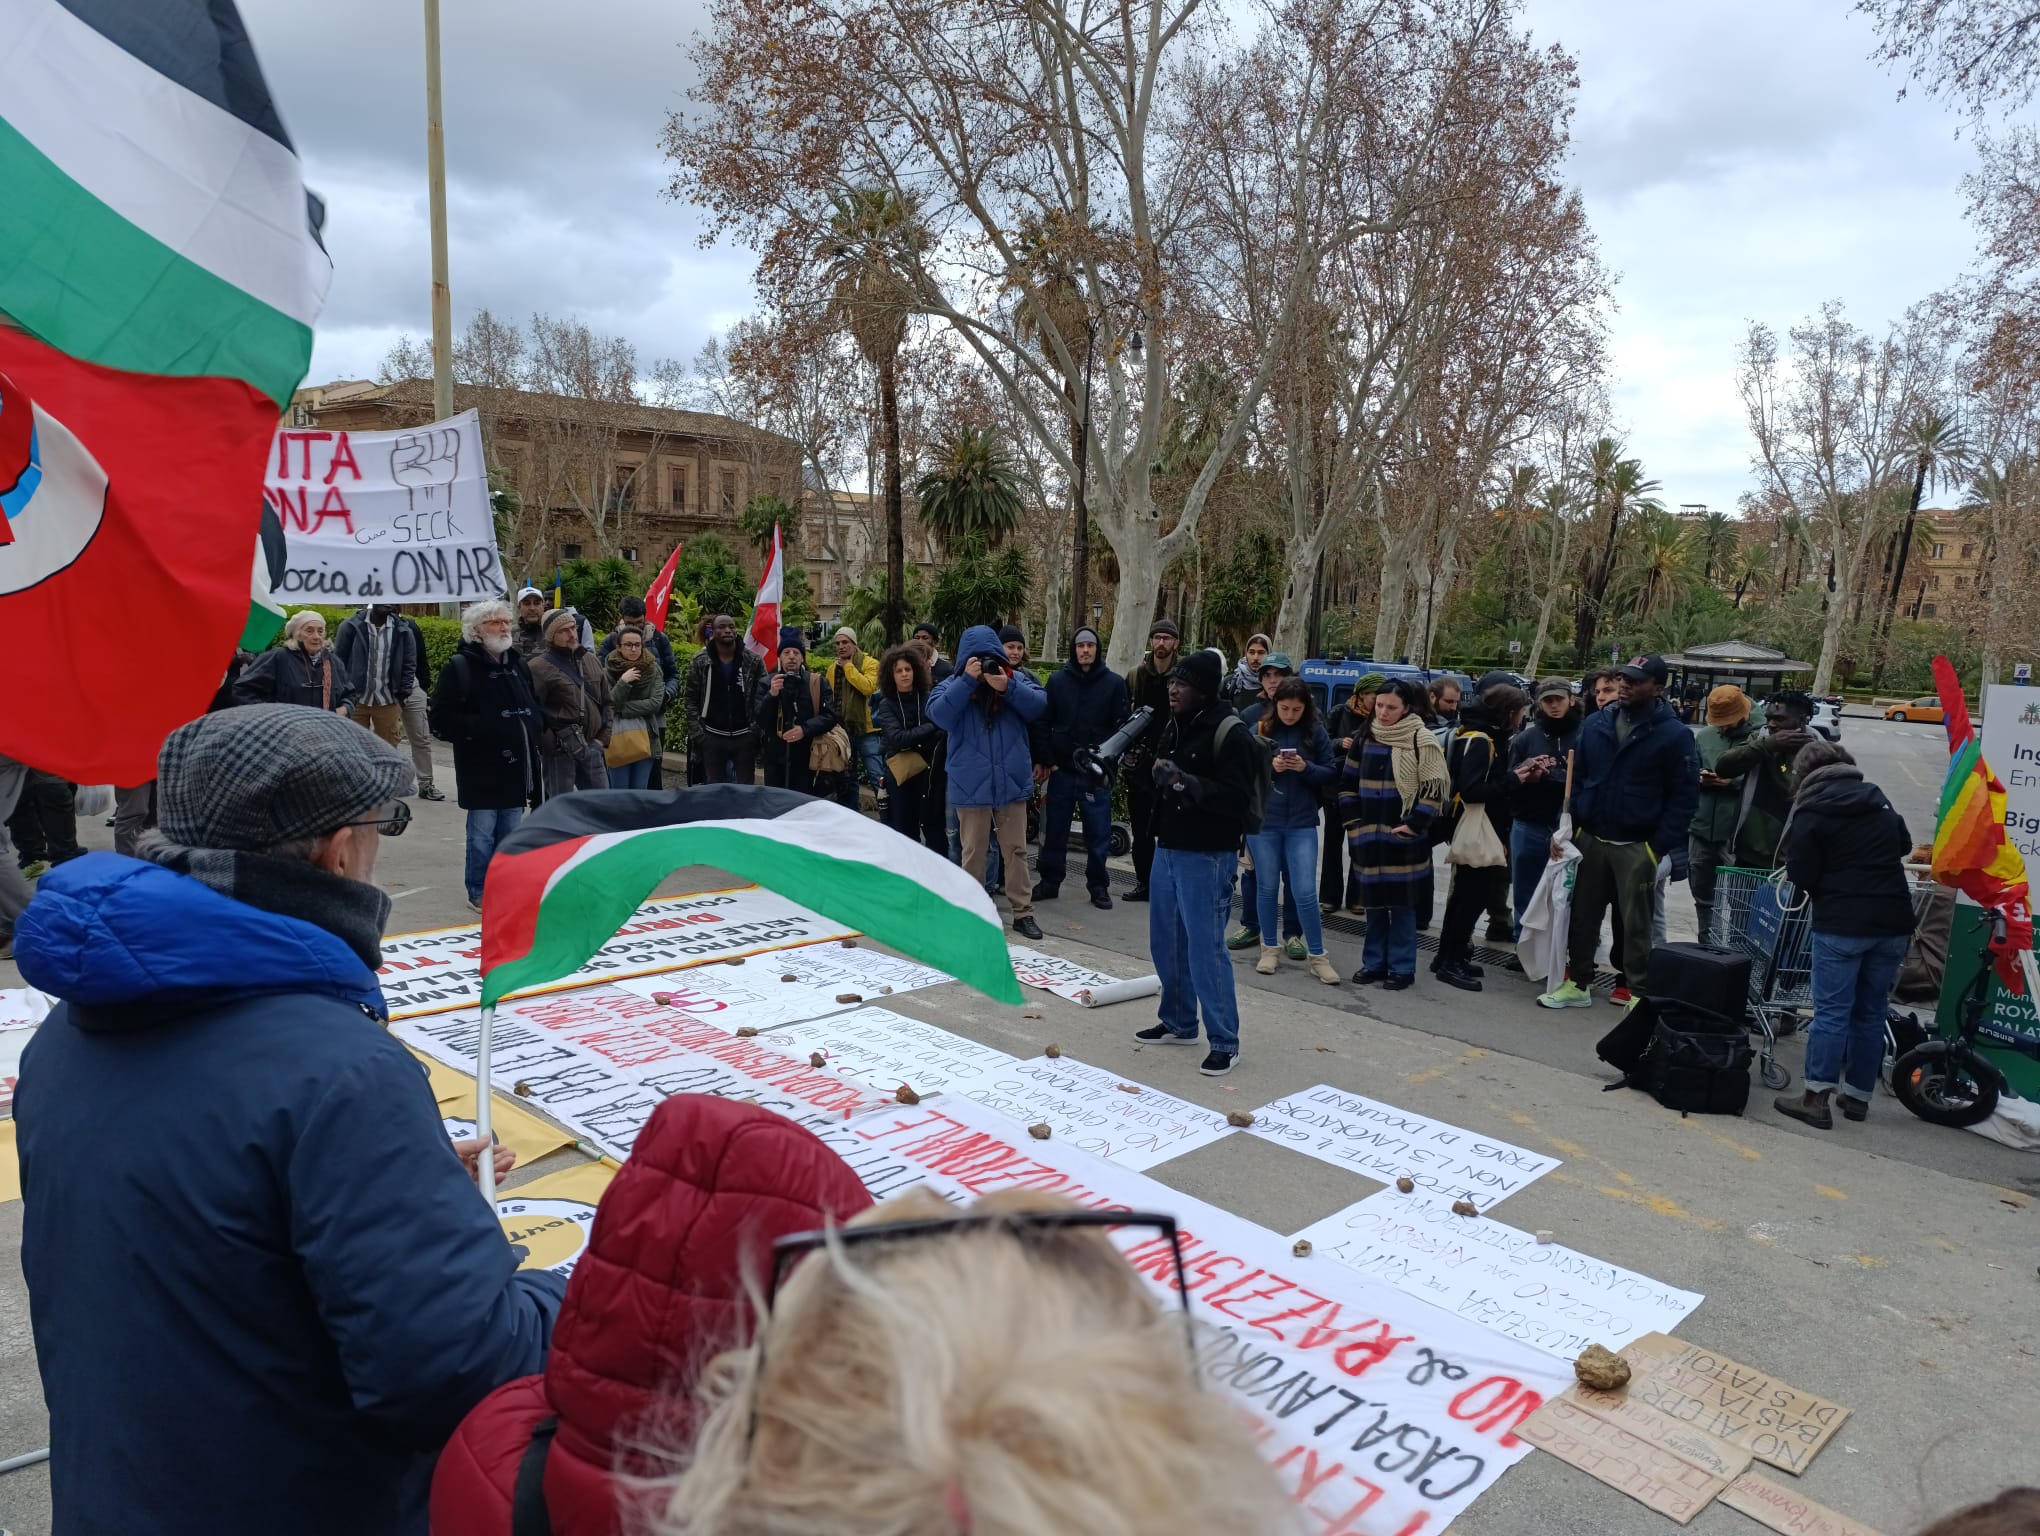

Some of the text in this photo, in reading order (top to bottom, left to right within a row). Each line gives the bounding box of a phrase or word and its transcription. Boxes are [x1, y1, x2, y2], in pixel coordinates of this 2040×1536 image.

[278, 431, 362, 484] ITA
[392, 509, 464, 543] SECK
[282, 548, 507, 597] oria di OMAR
[1304, 667, 1359, 677] POLIZIA
[2013, 743, 2040, 768] Ing
[2005, 811, 2040, 835] Big
[622, 948, 678, 969] LO
[679, 927, 809, 963] CONTRO
[649, 987, 728, 1014] CPR
[994, 1080, 1108, 1128] CAPORALATO
[1308, 1090, 1427, 1135] DOCUMENTI
[1075, 1137, 1128, 1158] NO
[1123, 1132, 1173, 1153] NO
[1316, 1137, 1334, 1150] IL
[1432, 1131, 1460, 1145] DI
[1453, 1165, 1519, 1192] NON
[1447, 1375, 1542, 1449] NO
[1642, 1381, 1808, 1470] NO AI CPR
[1719, 1387, 1823, 1445] BASTA
[1806, 1400, 1839, 1426] DI
